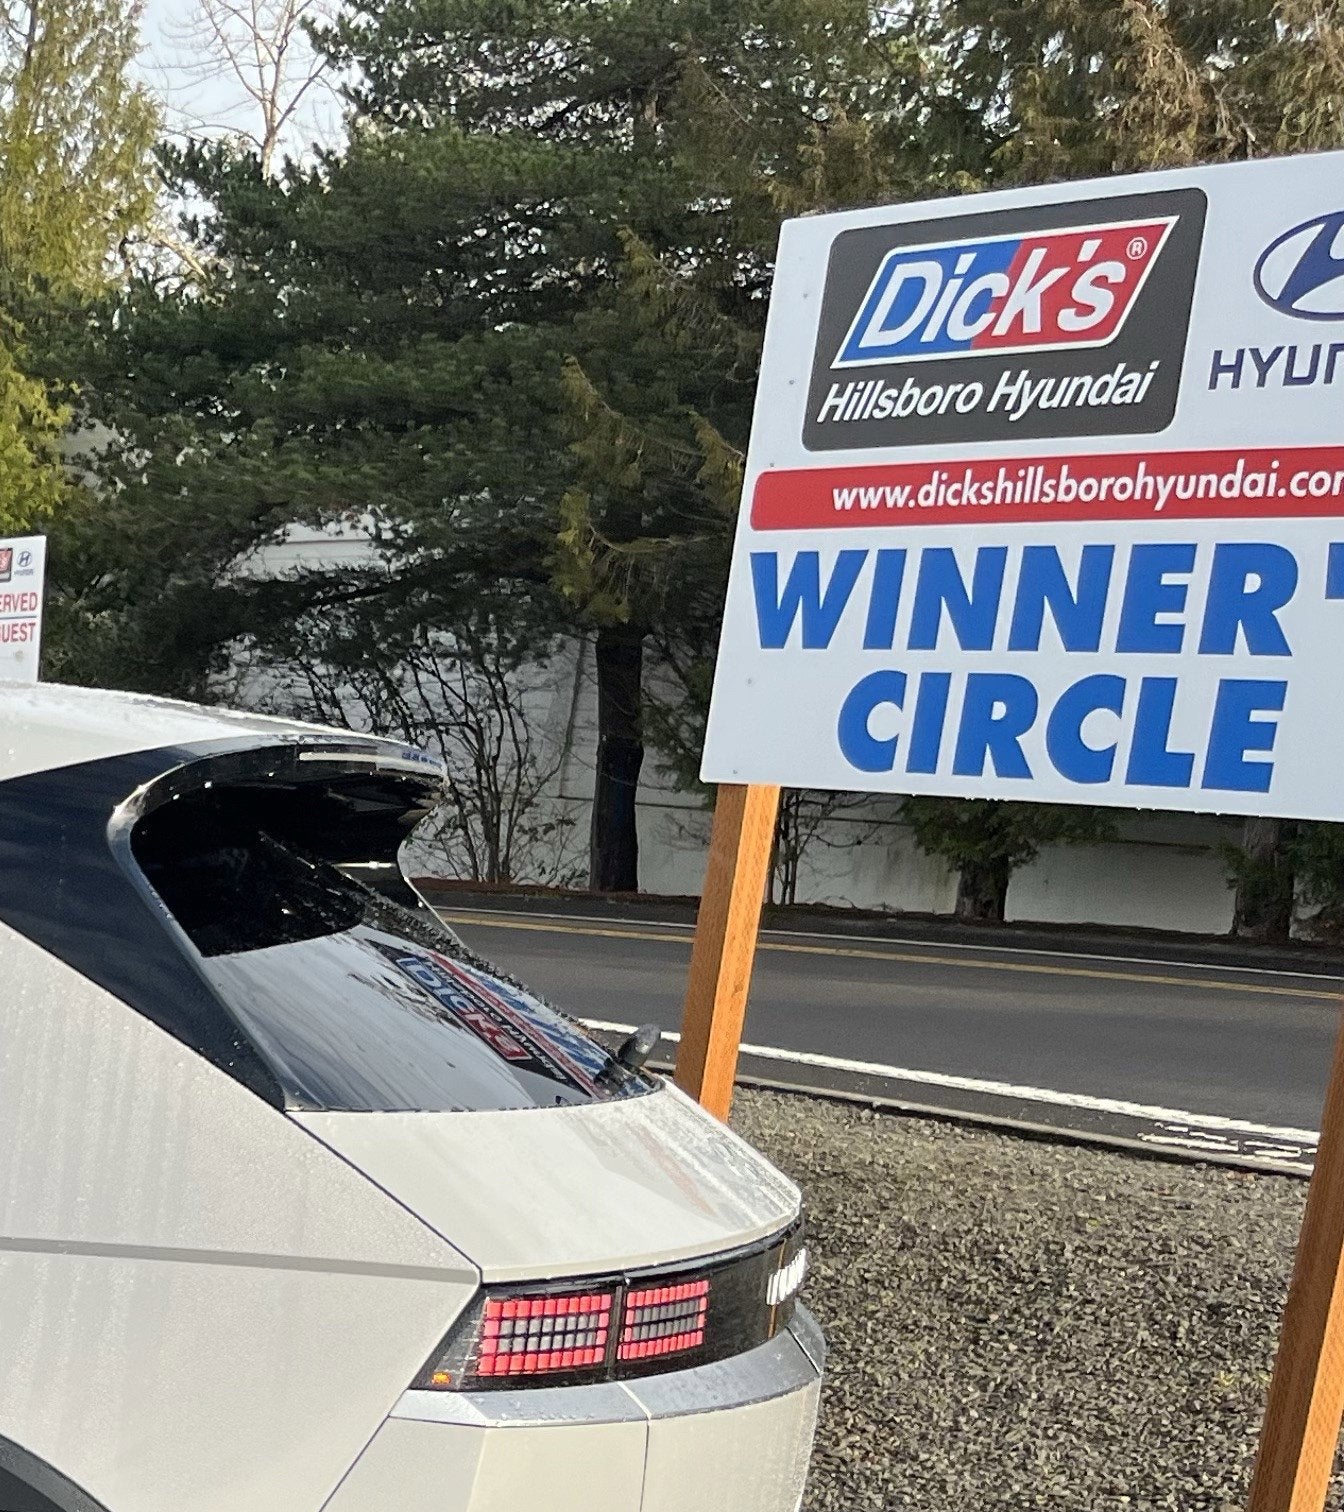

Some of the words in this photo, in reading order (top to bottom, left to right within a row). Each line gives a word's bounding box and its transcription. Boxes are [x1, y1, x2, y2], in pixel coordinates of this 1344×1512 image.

[858, 238, 1128, 350] Dick's
[816, 378, 983, 423] Hillsboro
[987, 360, 1161, 422] Hyundai
[837, 669, 1288, 794] CIRCLE
